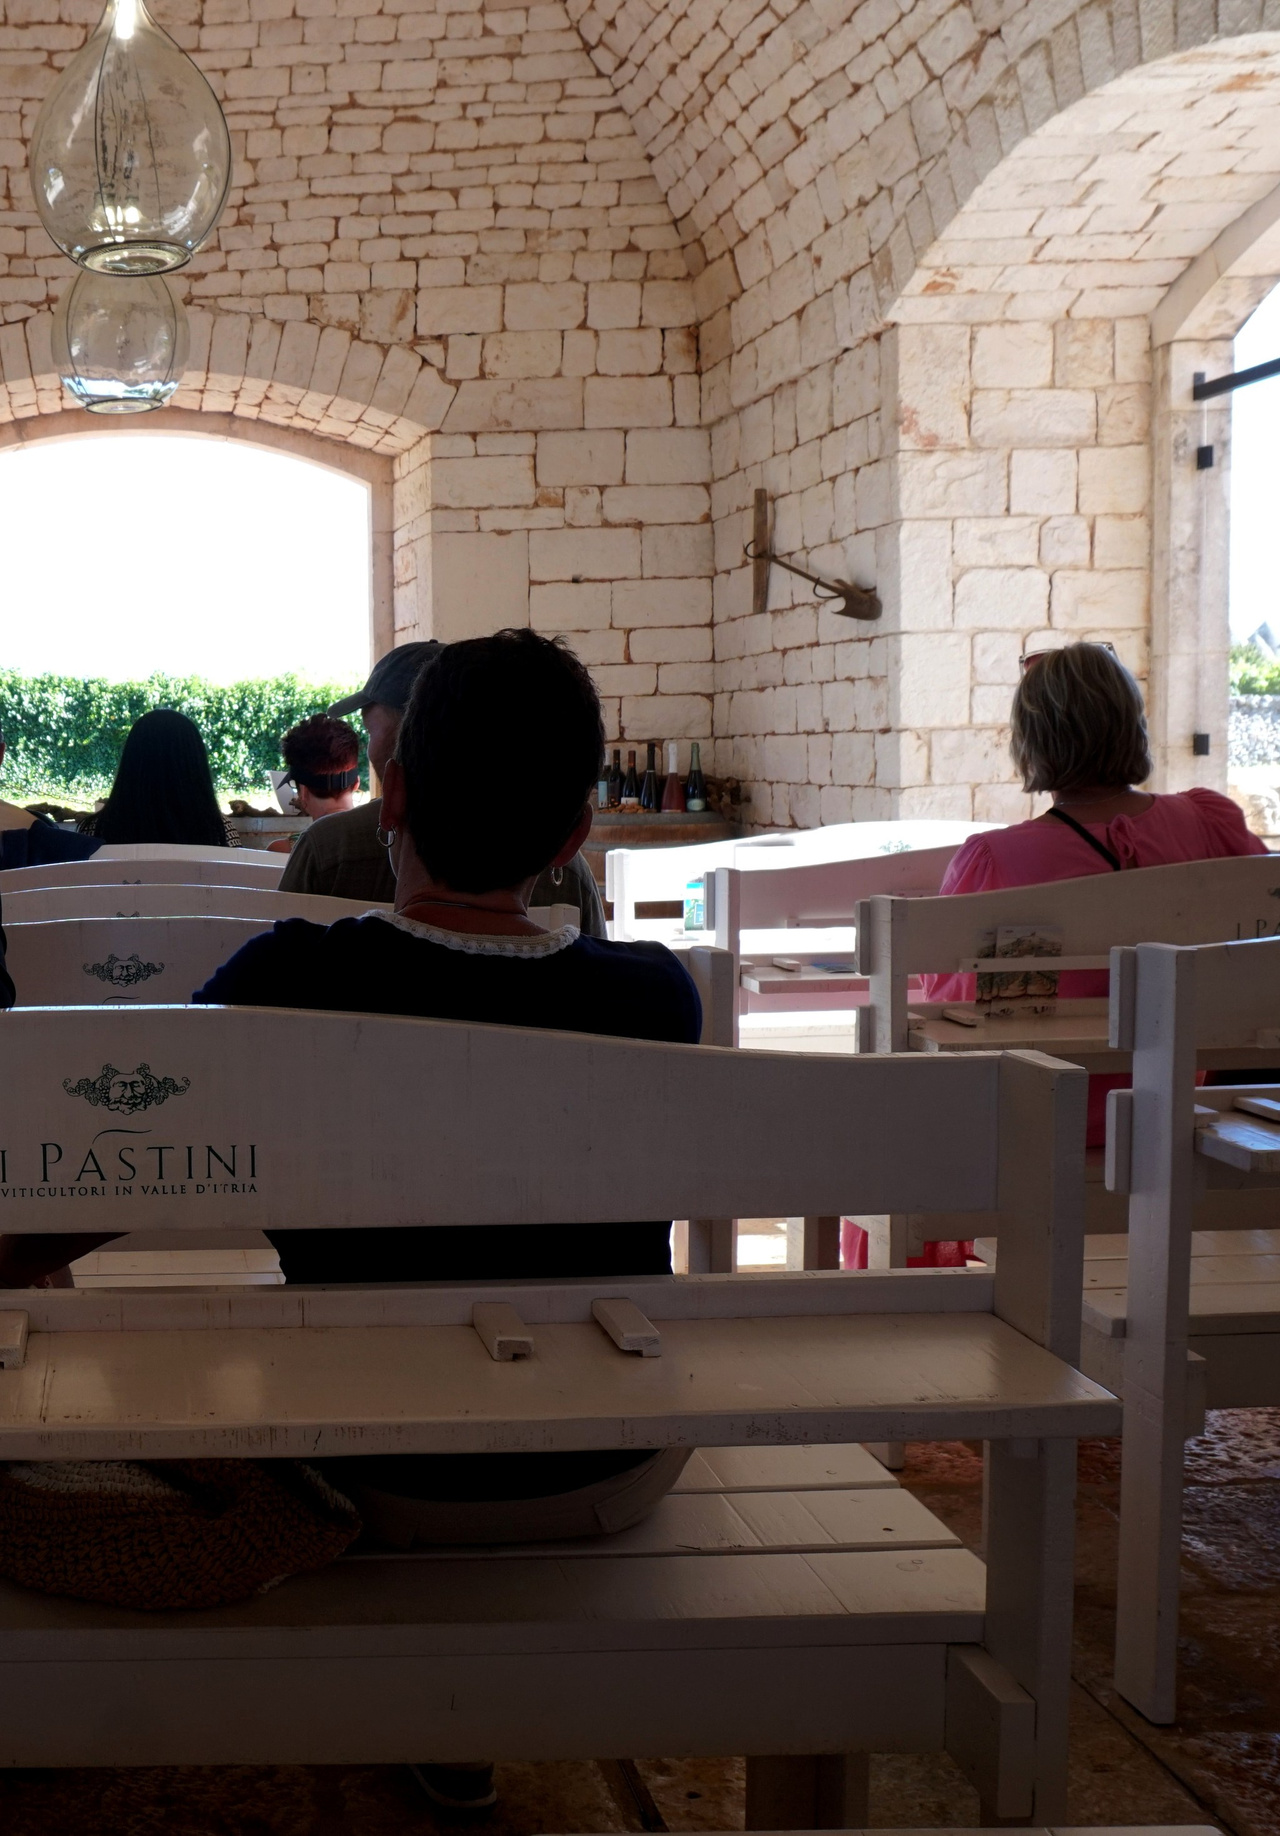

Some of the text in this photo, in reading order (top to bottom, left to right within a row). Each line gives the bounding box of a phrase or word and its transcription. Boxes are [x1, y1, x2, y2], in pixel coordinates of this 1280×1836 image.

[0, 1142, 258, 1184] I PASTINI
[0, 1183, 258, 1198] VITICULTORI IN VALLE D'ITRIA
